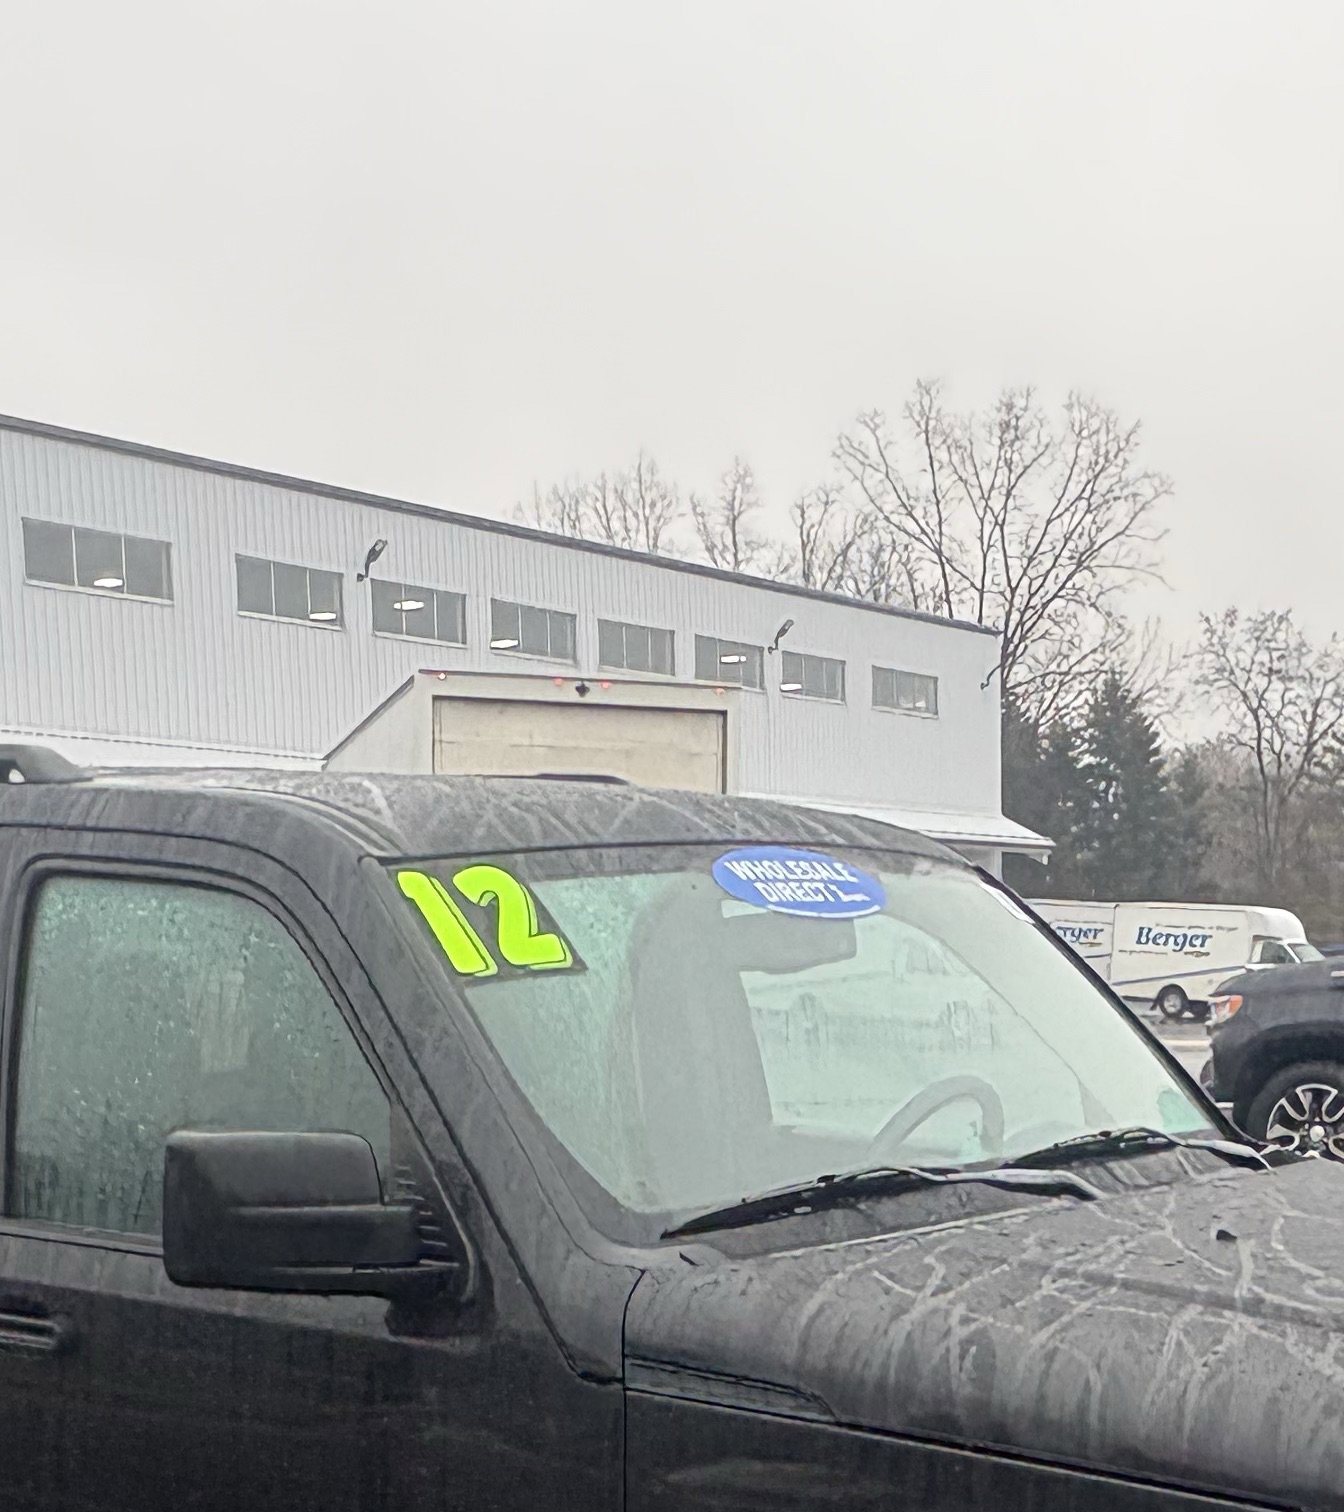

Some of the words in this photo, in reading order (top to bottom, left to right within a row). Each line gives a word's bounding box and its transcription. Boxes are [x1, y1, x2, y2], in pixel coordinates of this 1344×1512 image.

[724, 860, 859, 882] WHOLESALE
[753, 882, 836, 902] DIRECT
[397, 865, 573, 977] 12
[1136, 926, 1213, 953] Berger
